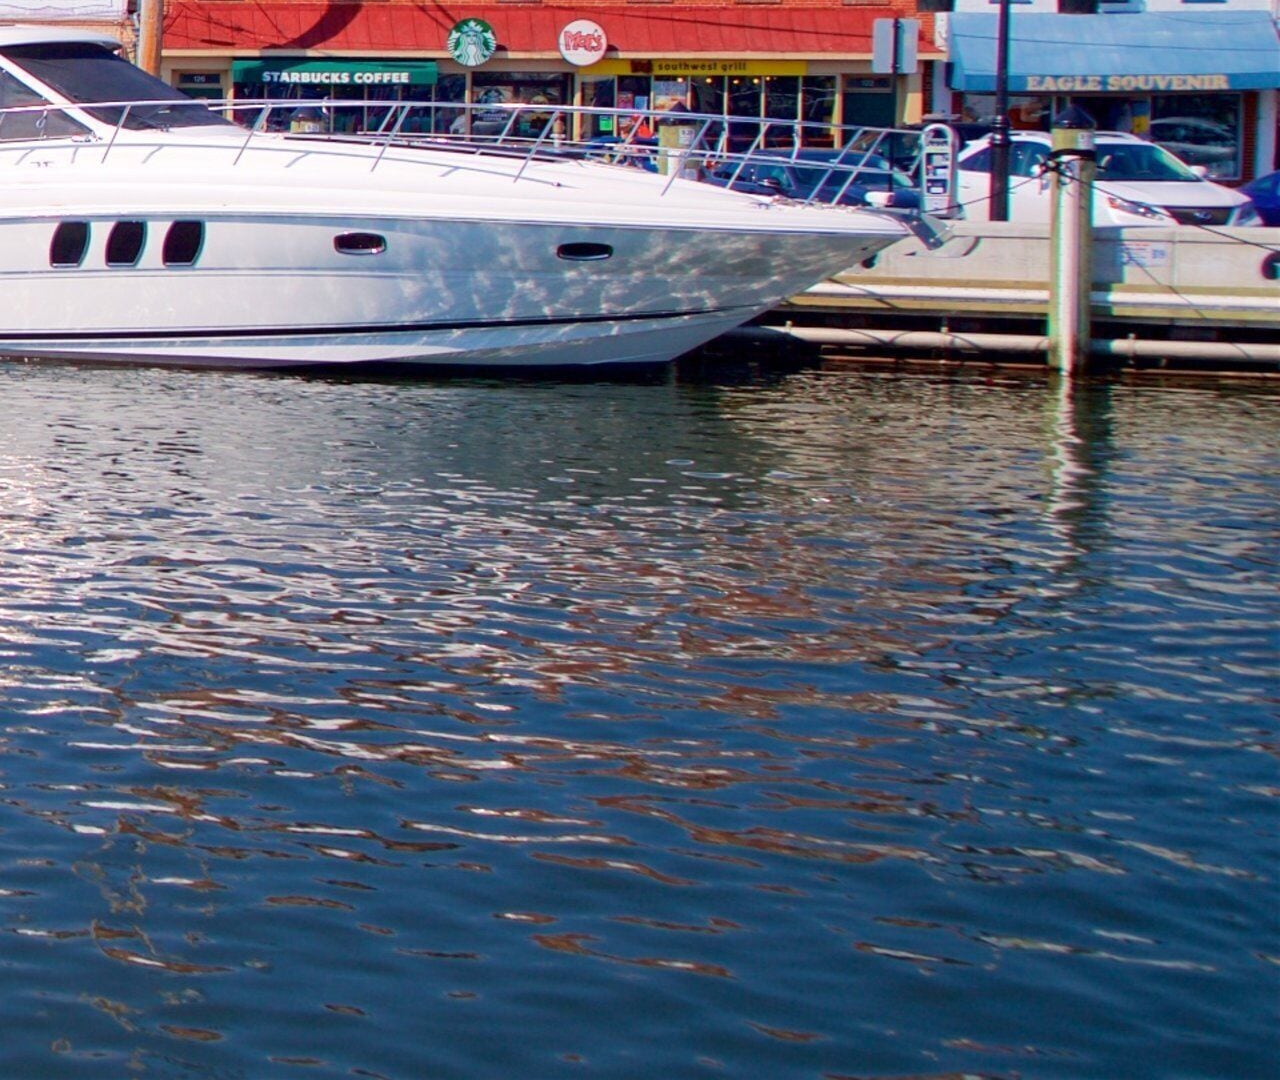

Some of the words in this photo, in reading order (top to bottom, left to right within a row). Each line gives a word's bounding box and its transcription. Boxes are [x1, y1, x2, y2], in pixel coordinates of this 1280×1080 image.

[563, 30, 603, 52] Moe's
[658, 63, 718, 71] southwest
[721, 62, 747, 72] grill
[262, 72, 350, 83] STARBUCKS
[353, 72, 409, 83] COFFEE
[1026, 76, 1102, 91] EAGLE
[1107, 75, 1230, 91] SOUVENIR
